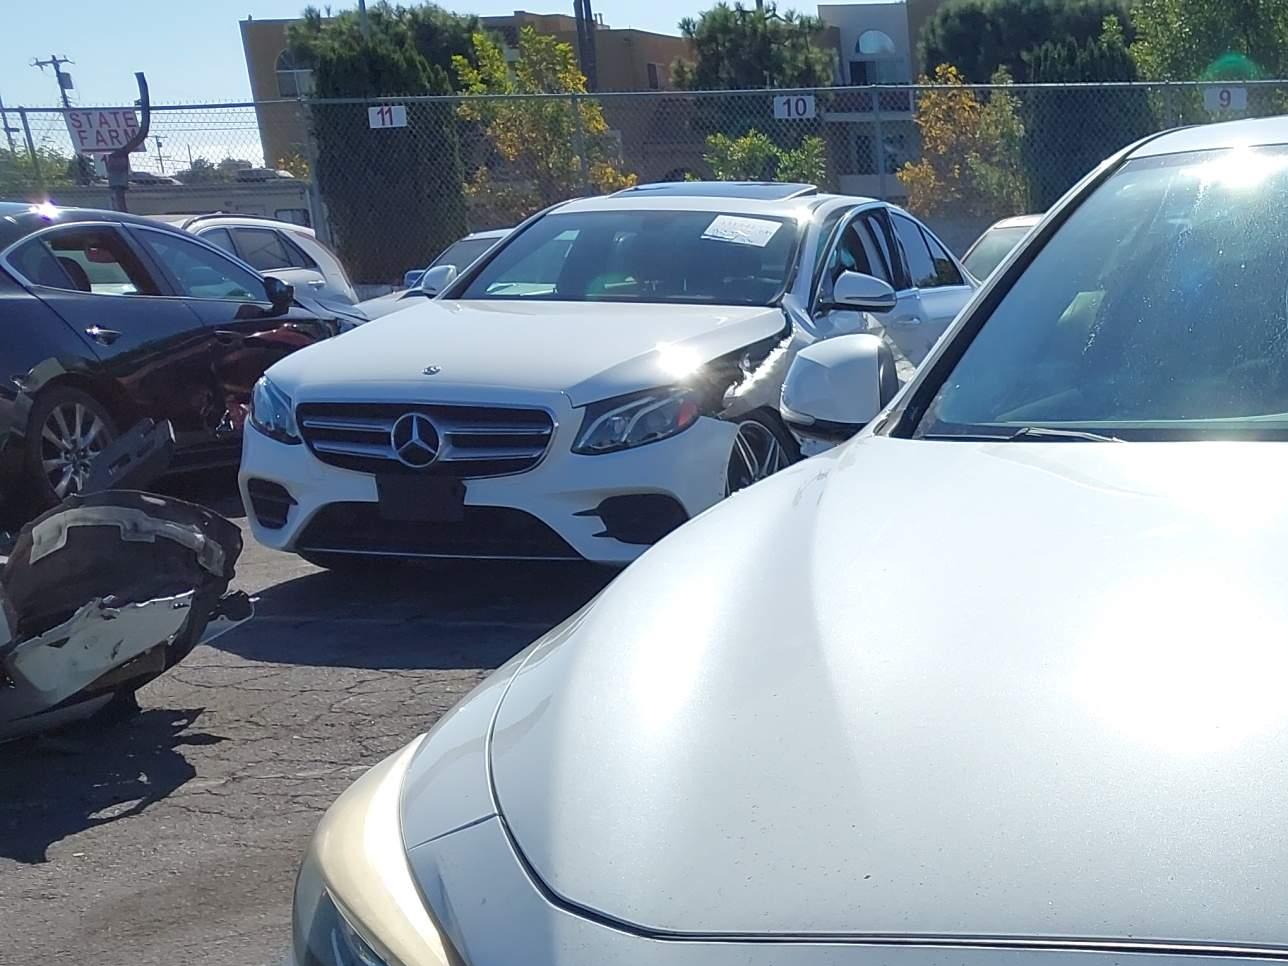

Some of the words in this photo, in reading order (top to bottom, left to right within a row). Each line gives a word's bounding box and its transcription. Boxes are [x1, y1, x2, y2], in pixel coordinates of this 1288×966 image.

[783, 98, 807, 117] 10
[1219, 90, 1231, 108] 9
[69, 111, 137, 129] STATE
[377, 107, 393, 126] 11
[77, 128, 139, 147] FARM
